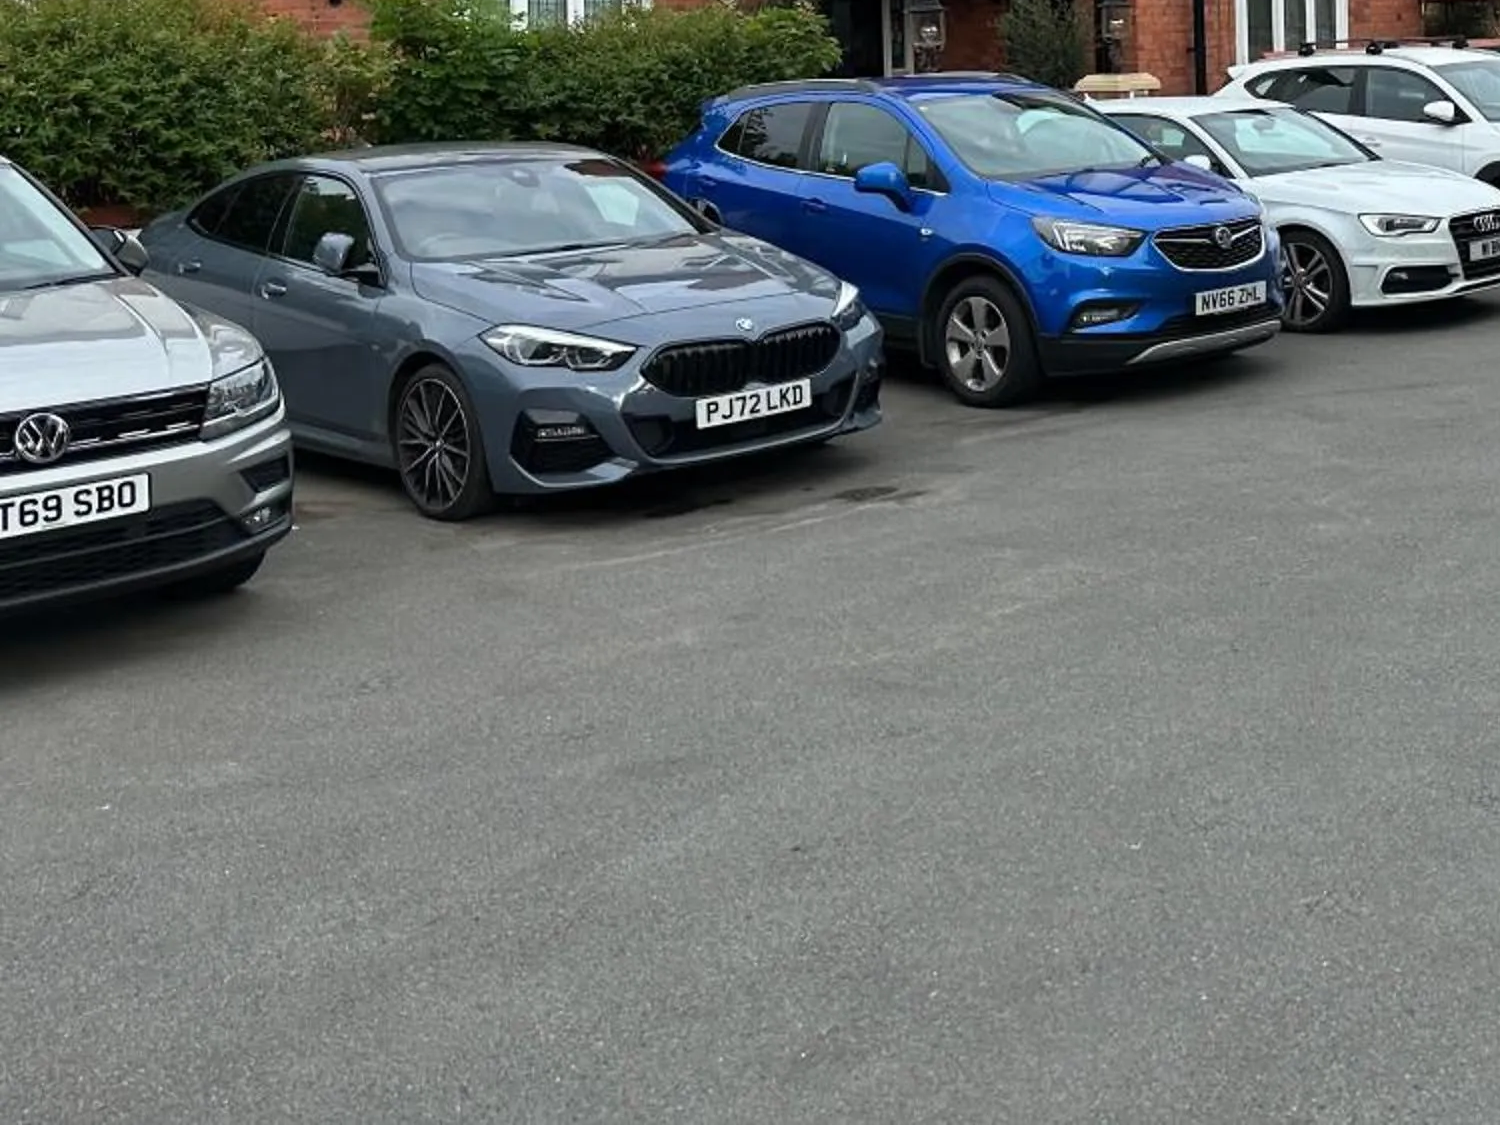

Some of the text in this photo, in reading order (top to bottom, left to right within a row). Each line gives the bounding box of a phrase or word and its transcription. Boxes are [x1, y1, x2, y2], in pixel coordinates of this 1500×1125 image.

[1201, 290, 1236, 312] NV66
[706, 384, 803, 423] PJ72 LKD
[73, 480, 137, 517] SBO
